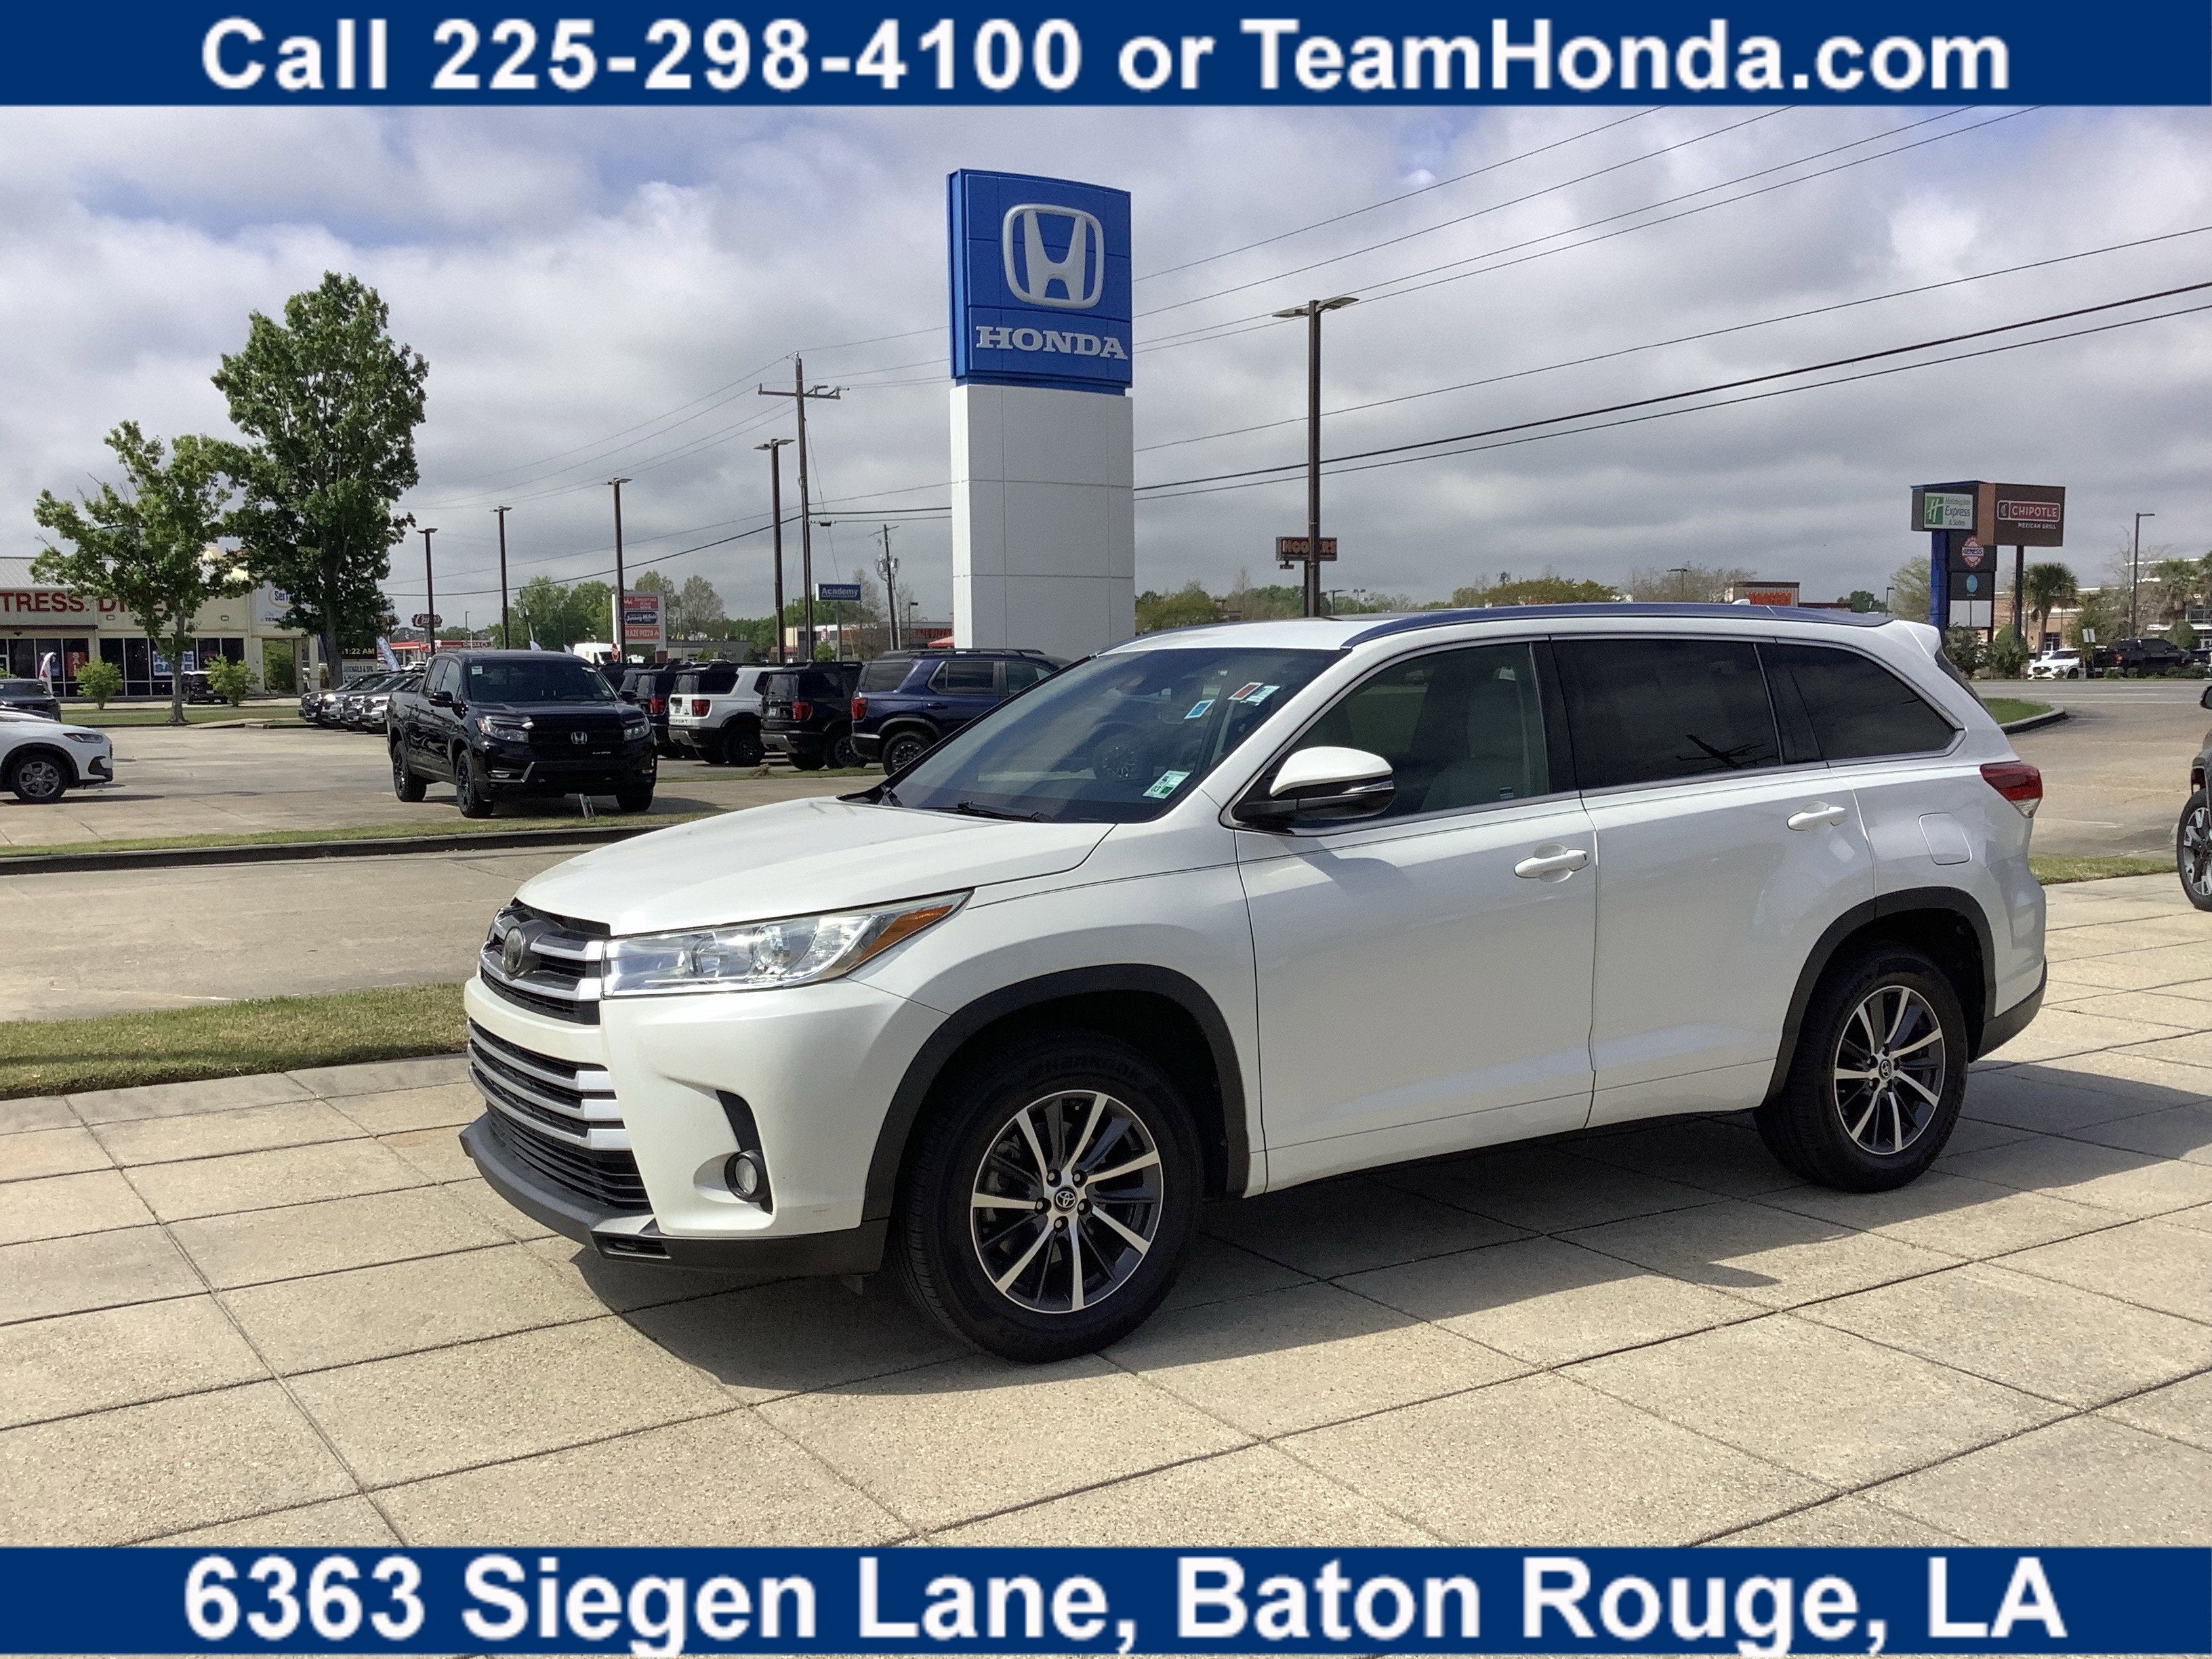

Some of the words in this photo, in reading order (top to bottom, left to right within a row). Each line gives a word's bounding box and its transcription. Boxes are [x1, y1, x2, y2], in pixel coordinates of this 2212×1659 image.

[976, 326, 1128, 359] HONDA
[1945, 506, 1970, 518] Express
[2011, 506, 2057, 517] CHIPOTLE
[1283, 540, 1336, 554] HOORS
[821, 587, 859, 598] Academy
